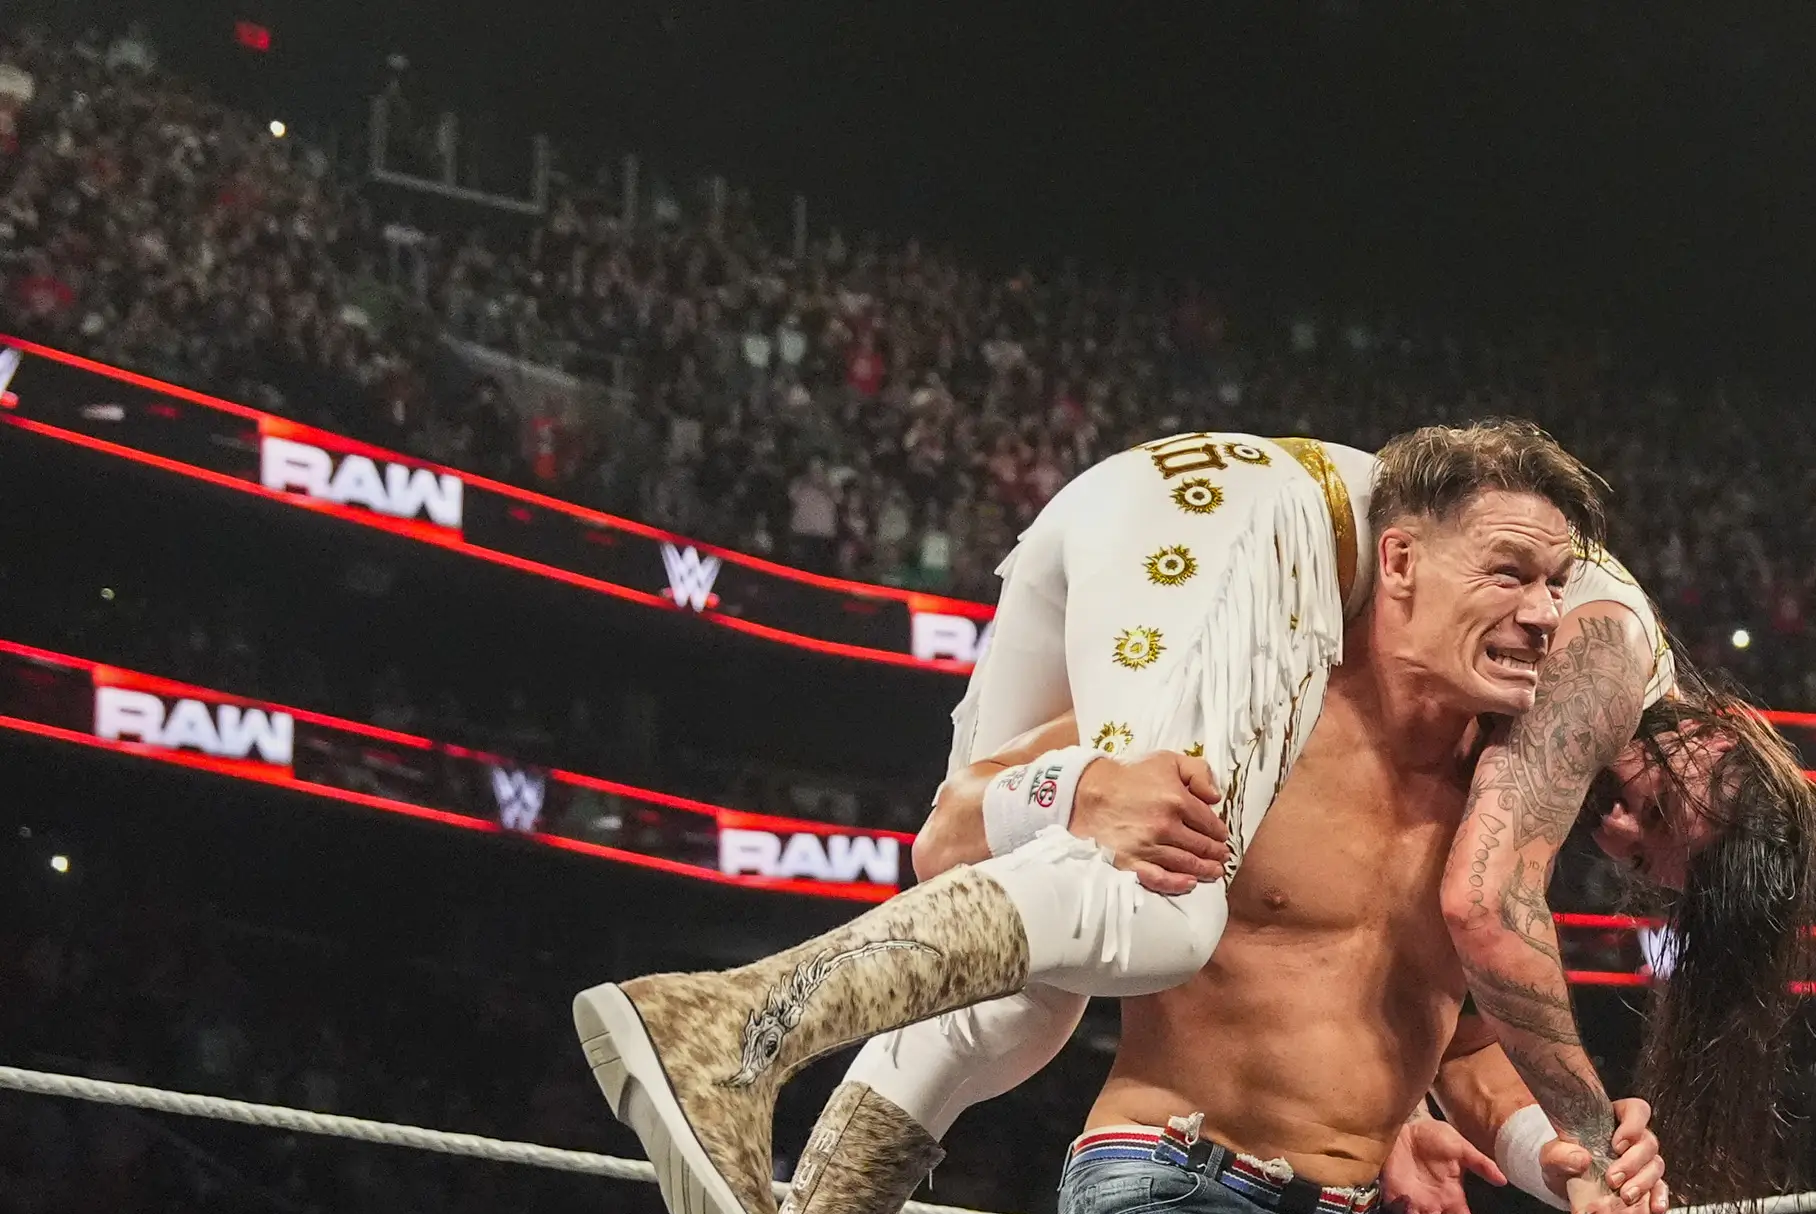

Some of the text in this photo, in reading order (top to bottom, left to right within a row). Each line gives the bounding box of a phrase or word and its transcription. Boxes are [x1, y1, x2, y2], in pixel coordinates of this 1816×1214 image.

[262, 437, 464, 530] RAW
[95, 686, 294, 766] RAW
[718, 826, 898, 886] RAW
